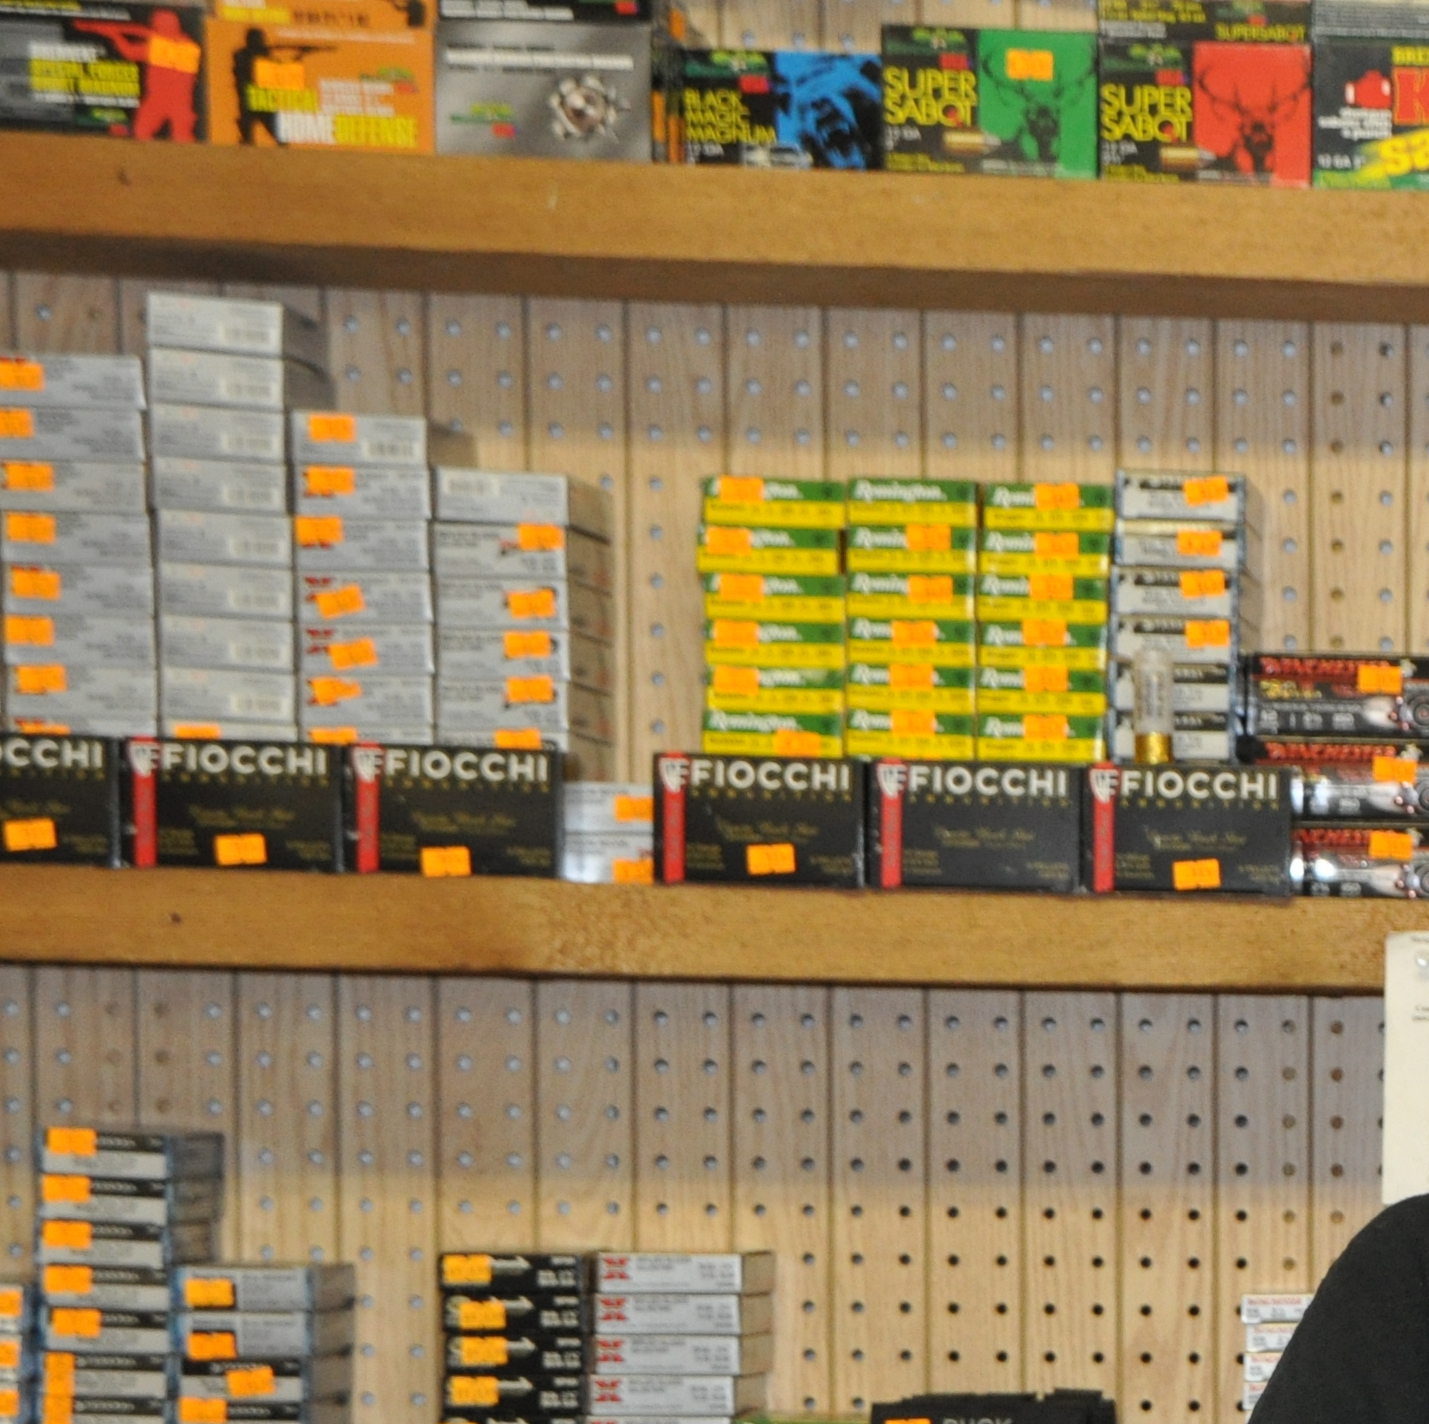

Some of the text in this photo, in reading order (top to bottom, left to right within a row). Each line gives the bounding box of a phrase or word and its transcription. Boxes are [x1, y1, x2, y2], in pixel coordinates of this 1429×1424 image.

[885, 71, 976, 100] SUPER
[885, 100, 975, 127] SABOT
[162, 740, 328, 775] FIOCCHI
[693, 761, 851, 792] FIOCCHI
[907, 765, 1068, 798] FIOCCHI
